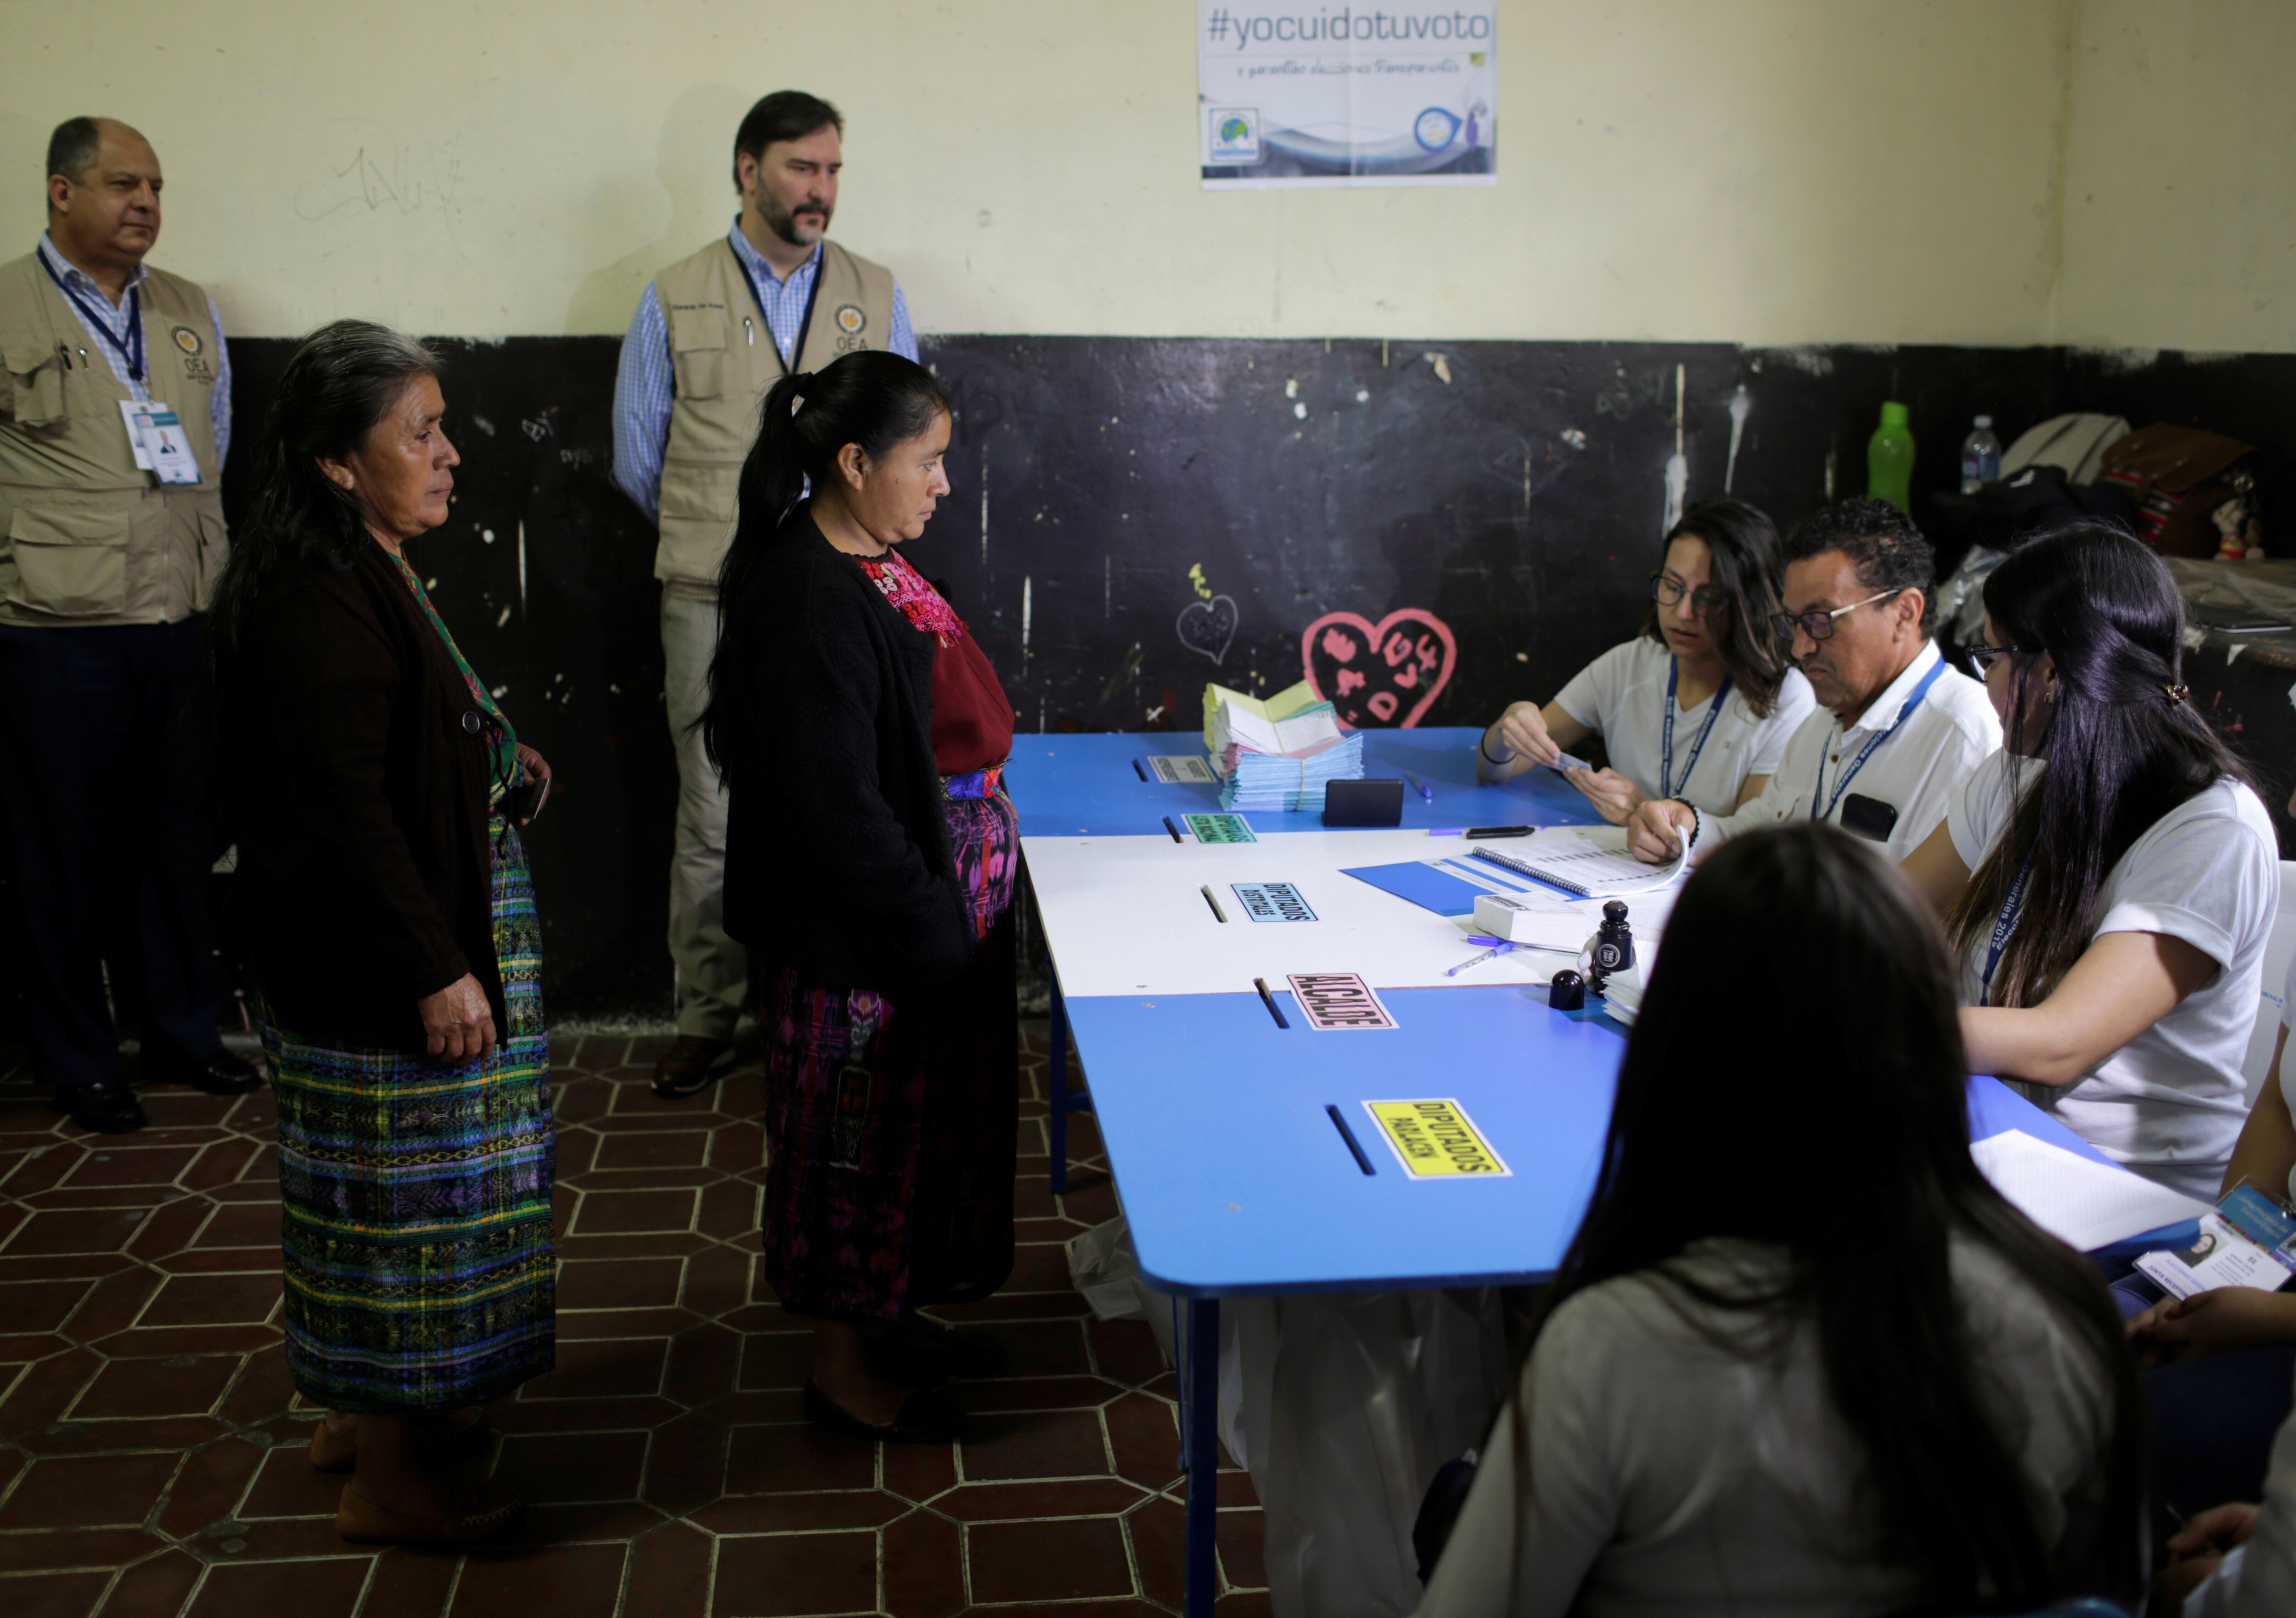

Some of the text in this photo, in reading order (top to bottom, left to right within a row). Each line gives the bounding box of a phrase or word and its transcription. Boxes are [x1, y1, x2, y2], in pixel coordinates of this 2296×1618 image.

[1207, 7, 1489, 50] #yocuidotuvoto
[837, 336, 868, 350] OEA
[184, 358, 210, 376] OEA
[1213, 816, 1250, 842] DIPUTADOS
[1241, 890, 1276, 915] DISTRITALES
[1263, 885, 1310, 920] DIPUTADOS
[2001, 864, 2028, 919] Generales
[1294, 976, 1383, 1026] ALCALDE
[1387, 1117, 1440, 1159] PARLACEN
[1413, 1103, 1491, 1172] DIPUTADOS
[2146, 1265, 2189, 1297] JUNTA RECEPTOR
[2166, 1259, 2191, 1279] ELECCIONES
[2190, 1279, 2206, 1291] GENER
